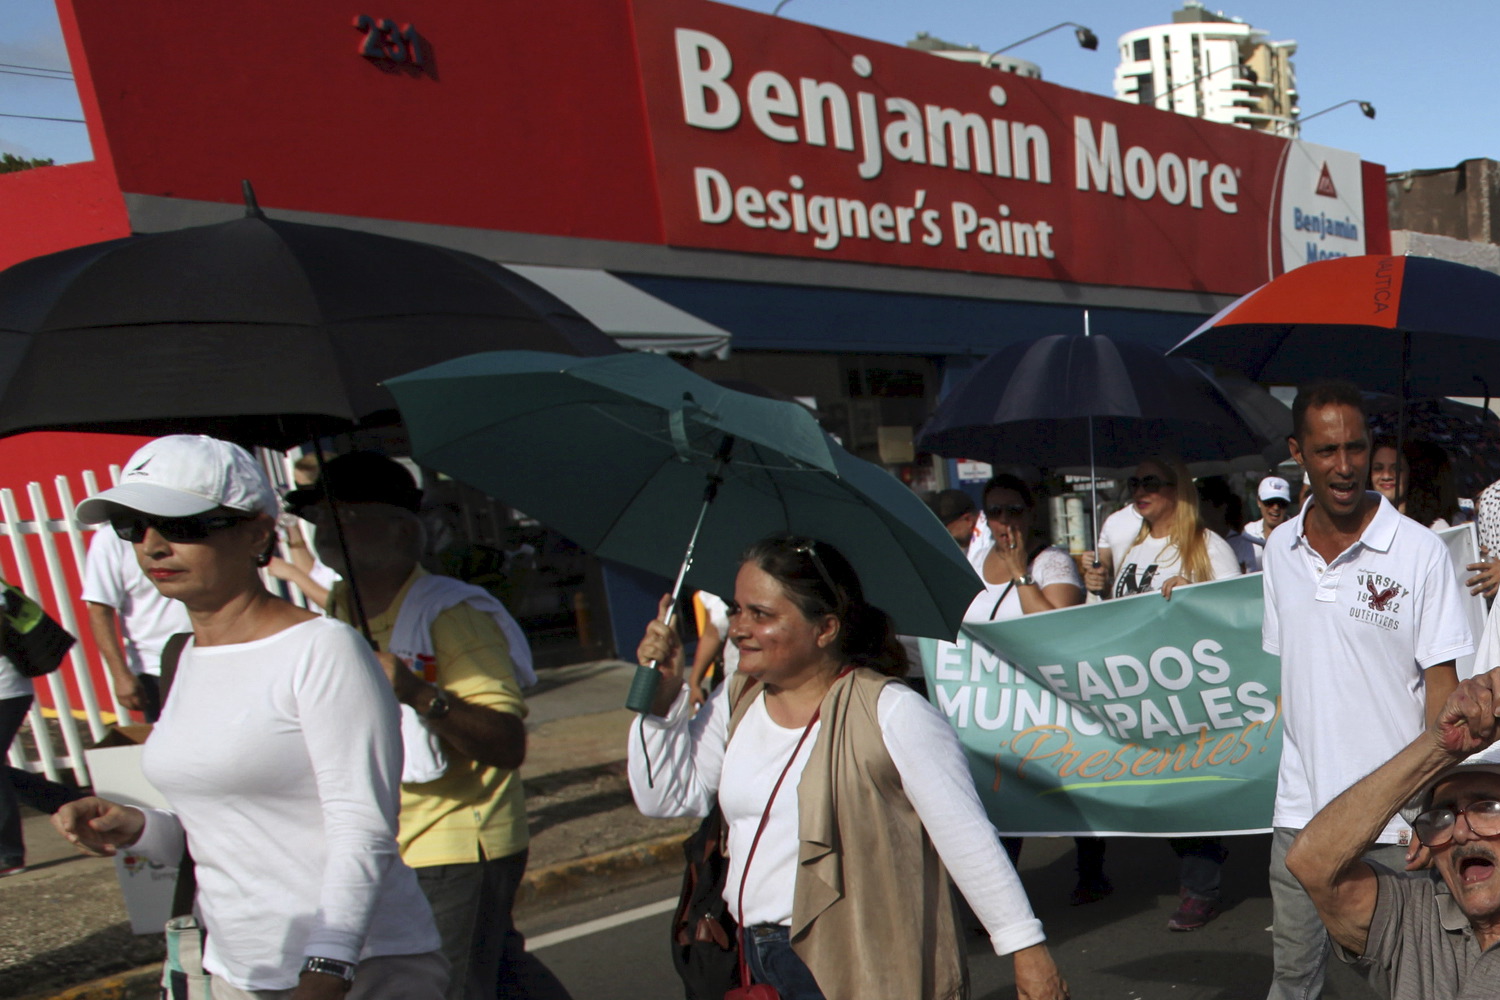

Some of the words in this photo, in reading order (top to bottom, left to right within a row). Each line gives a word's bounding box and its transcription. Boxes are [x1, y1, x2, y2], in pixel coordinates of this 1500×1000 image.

[352, 14, 421, 65] 231
[674, 27, 1052, 184] Benjamin
[693, 166, 943, 251] Designer's
[952, 201, 1055, 259] Paint
[1294, 206, 1359, 241] Benjamin
[1357, 574, 1410, 599] VARSITY
[1349, 607, 1400, 630] OUTFITTERS
[935, 638, 1231, 702] EMEADOS
[934, 681, 1277, 740] MUNICIPALES
